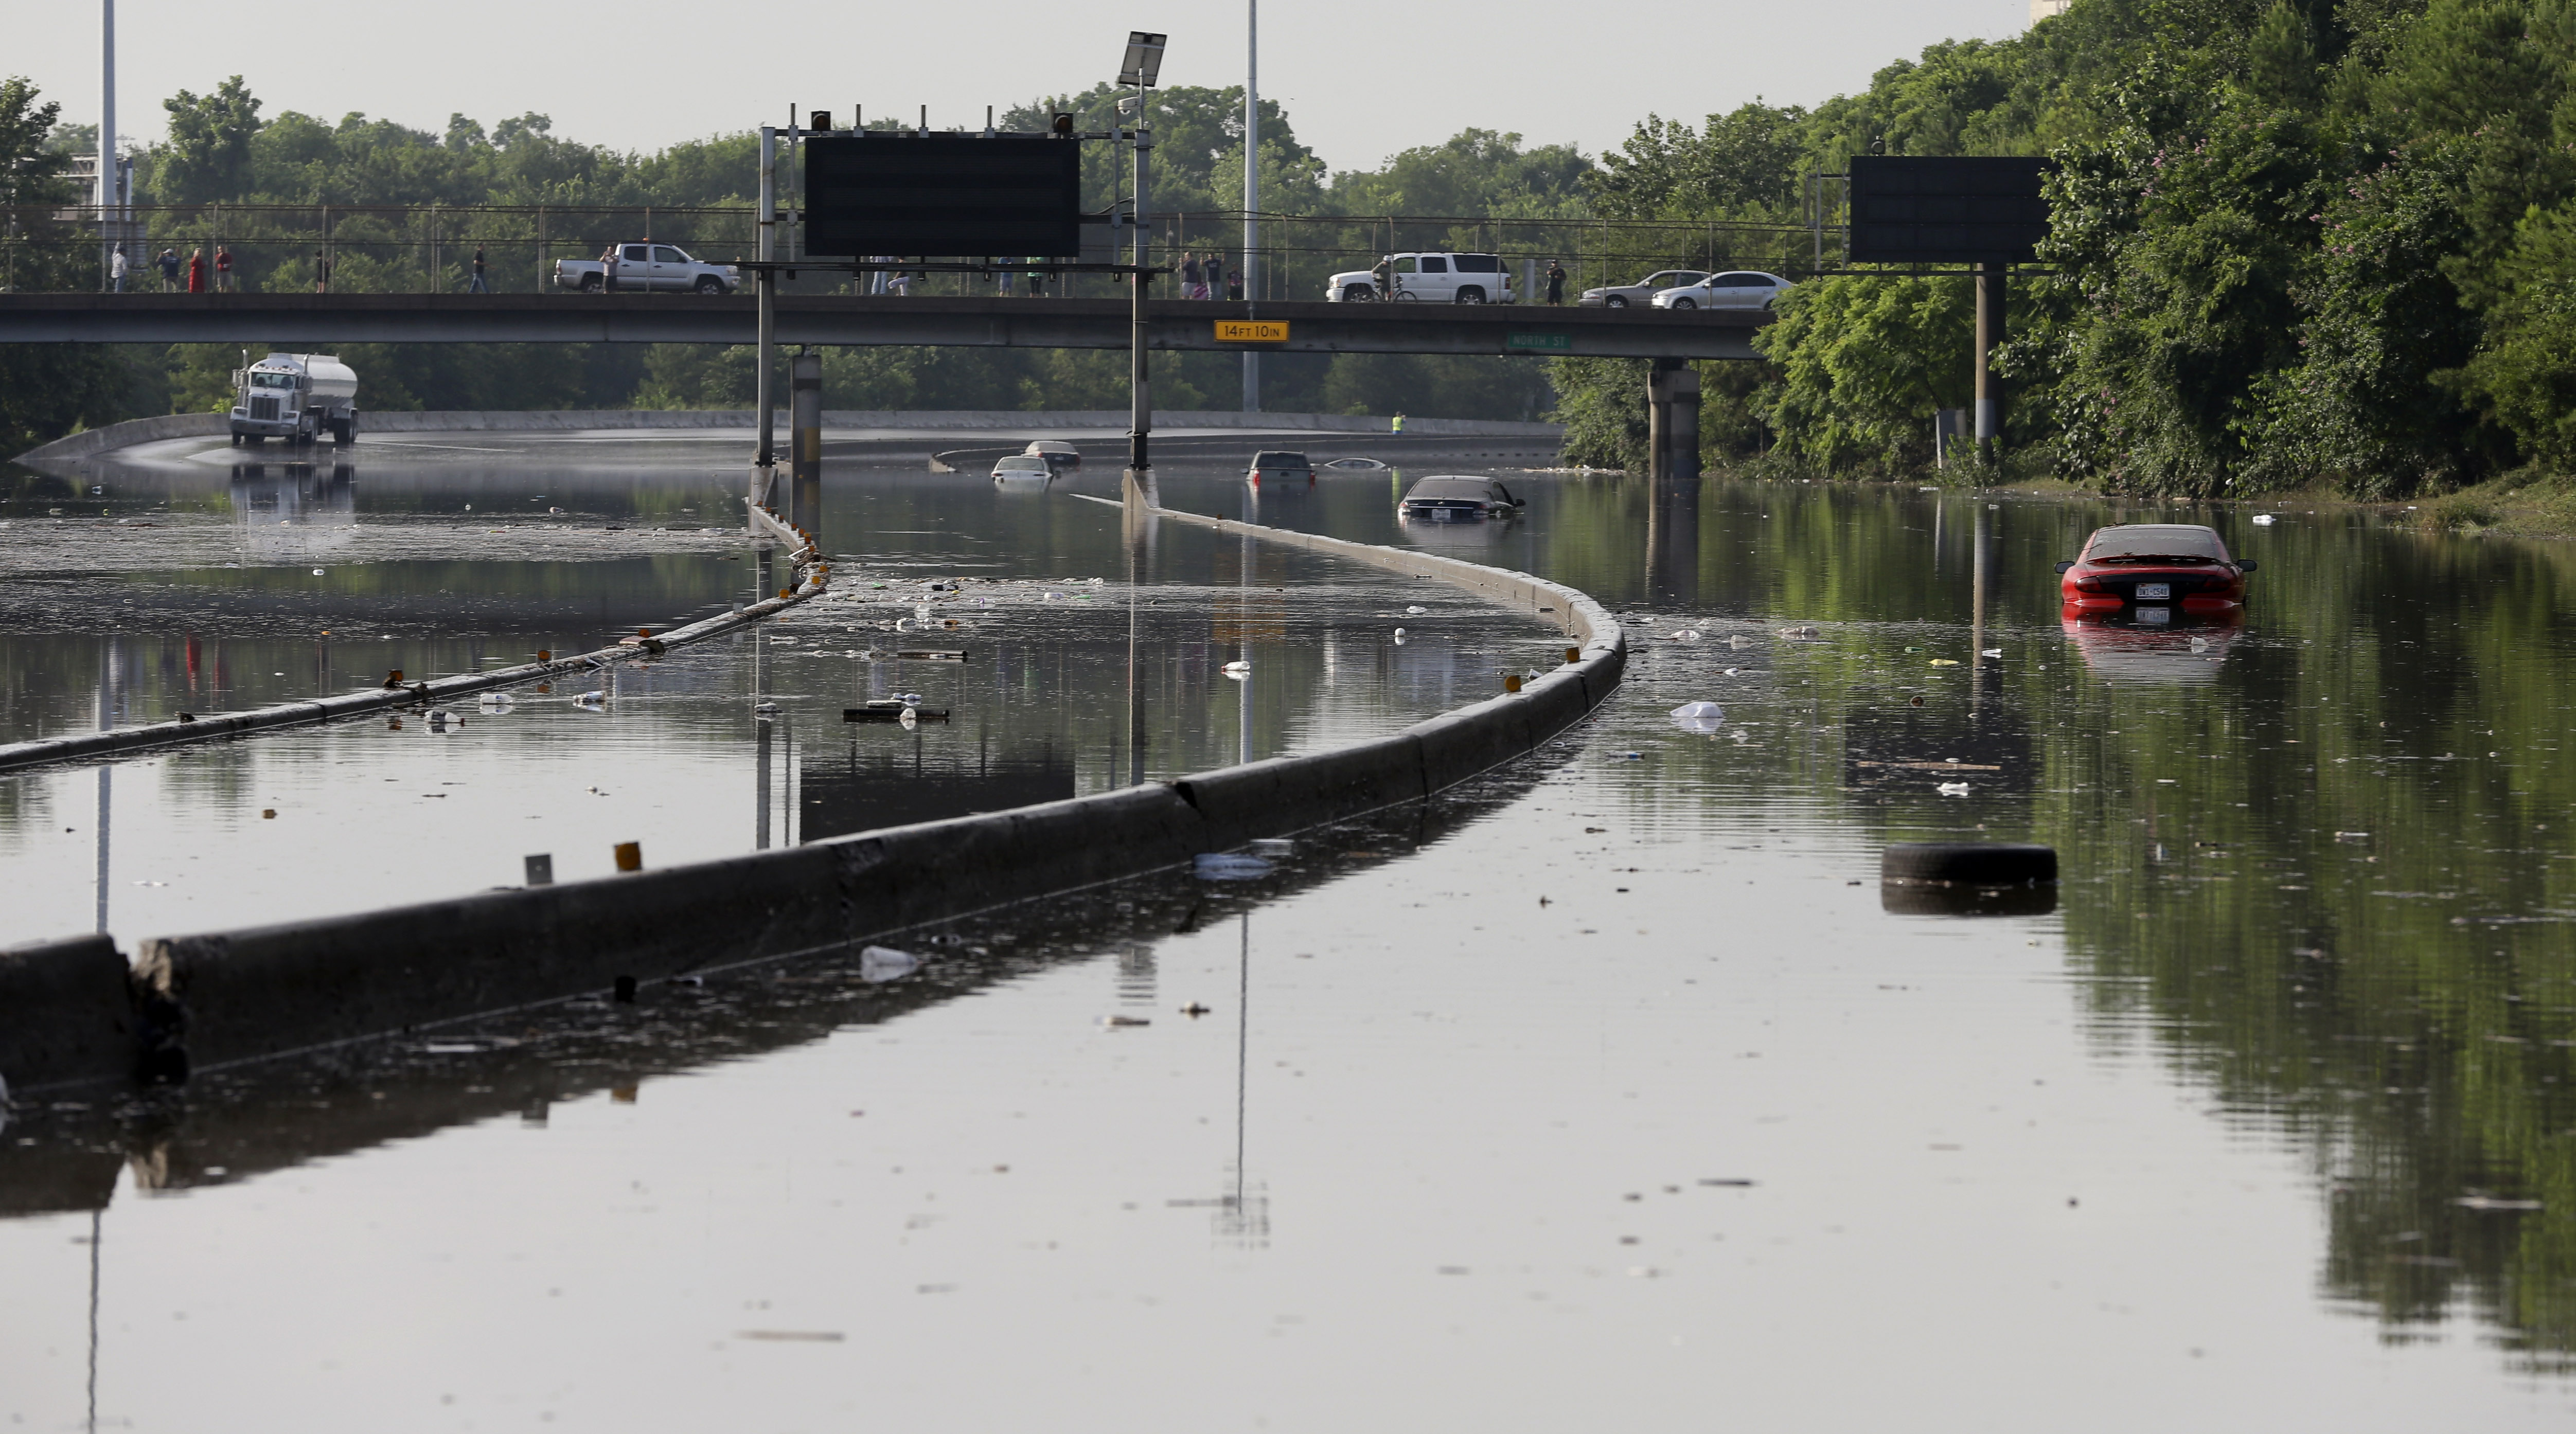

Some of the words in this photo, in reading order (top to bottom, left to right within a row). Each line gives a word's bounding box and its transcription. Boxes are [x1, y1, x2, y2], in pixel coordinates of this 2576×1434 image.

[1224, 325, 1251, 336] 14FT
[1255, 326, 1280, 337] 10IN
[1514, 335, 1546, 346] NORTH
[1553, 336, 1566, 346] ST
